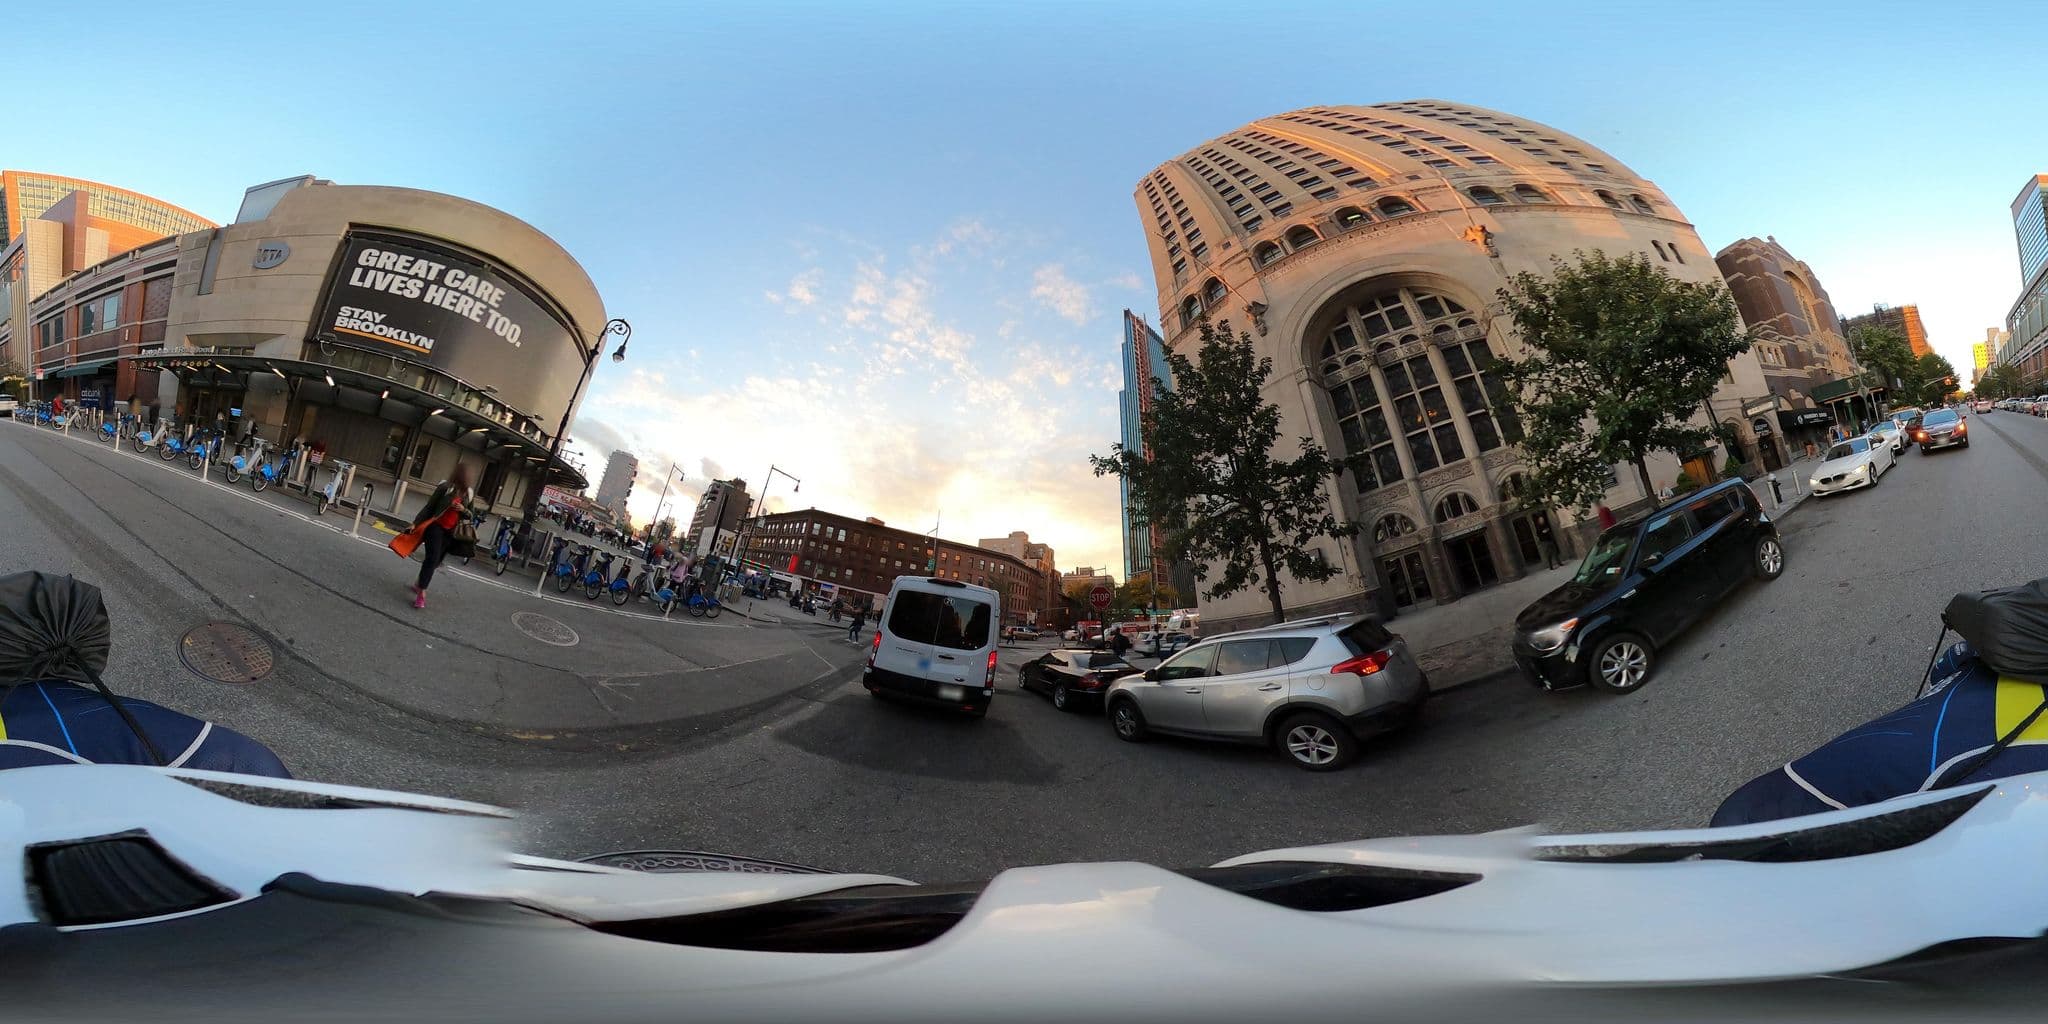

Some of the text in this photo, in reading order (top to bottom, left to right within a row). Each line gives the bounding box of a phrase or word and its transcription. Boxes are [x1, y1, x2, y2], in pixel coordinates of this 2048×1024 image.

[357, 248, 506, 308] GREAT CARE
[338, 306, 387, 323] STAY
[349, 267, 522, 348] LIVES HERE TOO.
[334, 316, 435, 350] BROOKLYN
[1091, 593, 1110, 602] STOP
